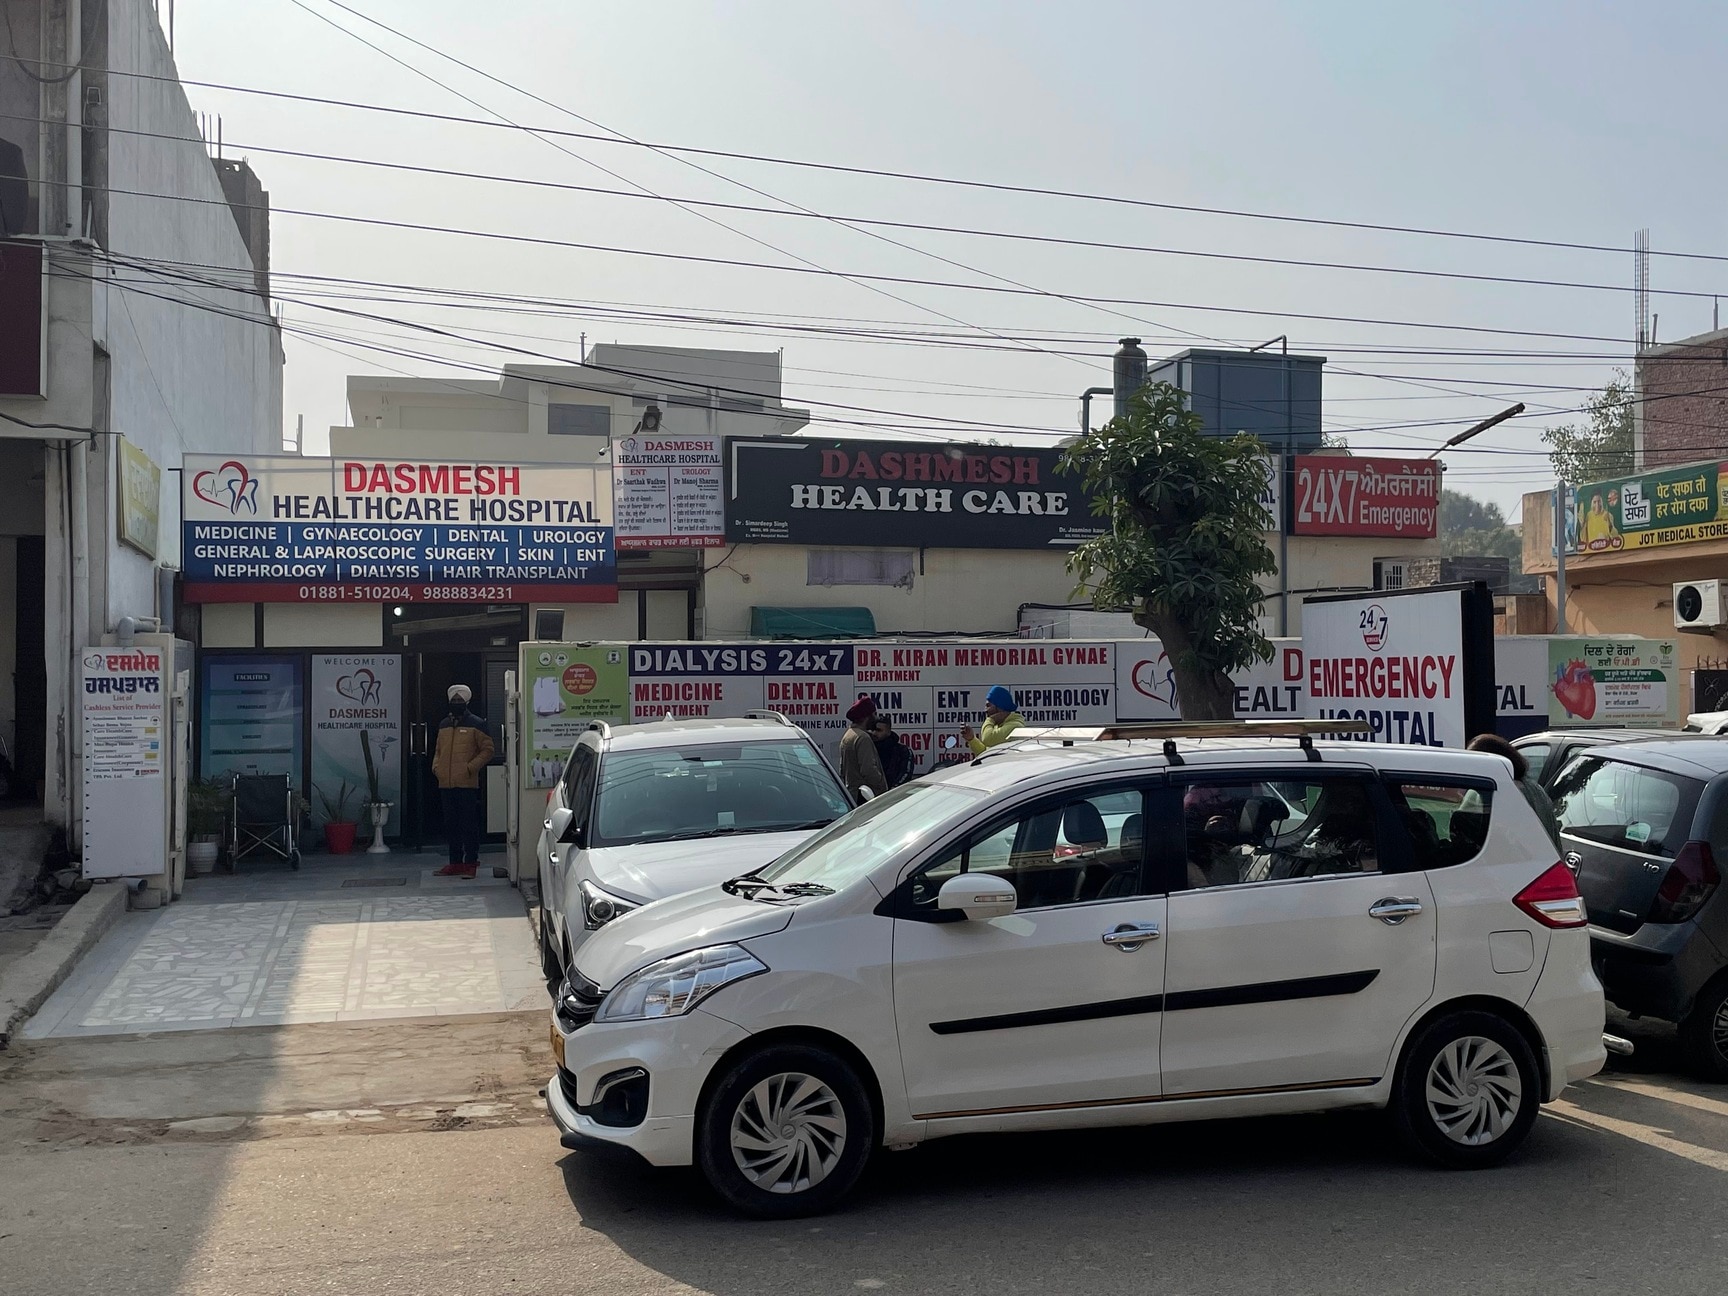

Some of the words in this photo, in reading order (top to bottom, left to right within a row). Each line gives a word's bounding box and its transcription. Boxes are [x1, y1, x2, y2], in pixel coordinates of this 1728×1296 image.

[644, 441, 713, 451] DASMESH
[618, 455, 676, 464] HEALTHCARE
[679, 455, 720, 464] HOSPITAL
[820, 449, 1040, 485] DASHMESH
[344, 462, 520, 496] DASMESH
[1657, 482, 1670, 498] पेट
[1672, 481, 1693, 496] सफा
[1695, 475, 1706, 492] तो
[790, 484, 952, 513] HEALTH
[962, 490, 1068, 516] CARE
[1298, 468, 1359, 524] 24X7
[1624, 488, 1638, 506] पेट
[272, 496, 460, 520] HEALTHCARE
[470, 498, 600, 523] HOSPITAL
[1360, 500, 1435, 531] Emergency
[1624, 506, 1647, 521] सफा
[1656, 503, 1668, 518] हर
[1670, 498, 1687, 516] रोग
[194, 526, 277, 540] MEDICINE
[302, 528, 422, 543] GYNAECOLOGY
[448, 529, 508, 542] DENTAL
[532, 530, 606, 544] UROLOGY
[1639, 533, 1654, 545] JOT
[1657, 528, 1696, 542] MEDICAL
[1698, 524, 1728, 538] STORE
[194, 545, 272, 559] GENERAL
[275, 545, 289, 559] &
[294, 546, 416, 560] LAPAROSCOPIC
[424, 547, 495, 561] SURGERY
[518, 548, 554, 561] SKIN
[576, 549, 606, 562] ENT
[214, 563, 326, 578] NEPHROLOGY
[350, 564, 419, 578] DIALYSIS
[443, 566, 481, 579] HAIR
[485, 566, 588, 580] TRANSPLANT
[299, 586, 414, 600] 01881-510204,
[423, 587, 512, 600] 9888834231
[857, 649, 887, 667] DR.
[894, 649, 948, 666] KIRAN
[954, 648, 1046, 666] MEMORIAL
[1053, 647, 1107, 665] GYNAE
[1584, 643, 1604, 656] ਦਿਲ
[1606, 643, 1614, 656] ਦੇ
[324, 658, 375, 666] WELCOME
[382, 658, 394, 666] TO
[634, 649, 767, 672] DIALYSIS
[778, 649, 844, 671] 24x7
[85, 676, 160, 694] ਹਸਪਤਾਲ
[857, 670, 920, 682] DEPARTMENT
[1310, 655, 1455, 699] EMERGENCY
[635, 683, 723, 701] MEDICINE
[768, 682, 838, 700] DENTAL
[938, 691, 970, 708] ENT
[1015, 689, 1109, 707] NEPHROLOGY
[329, 708, 387, 719] DASMESH
[635, 704, 710, 717] DEPARTMENT
[938, 712, 986, 722] DEPARTM
[318, 722, 363, 730] HEALTHCARE
[364, 722, 397, 730] HOSPITAL
[824, 720, 847, 728] KAUR
